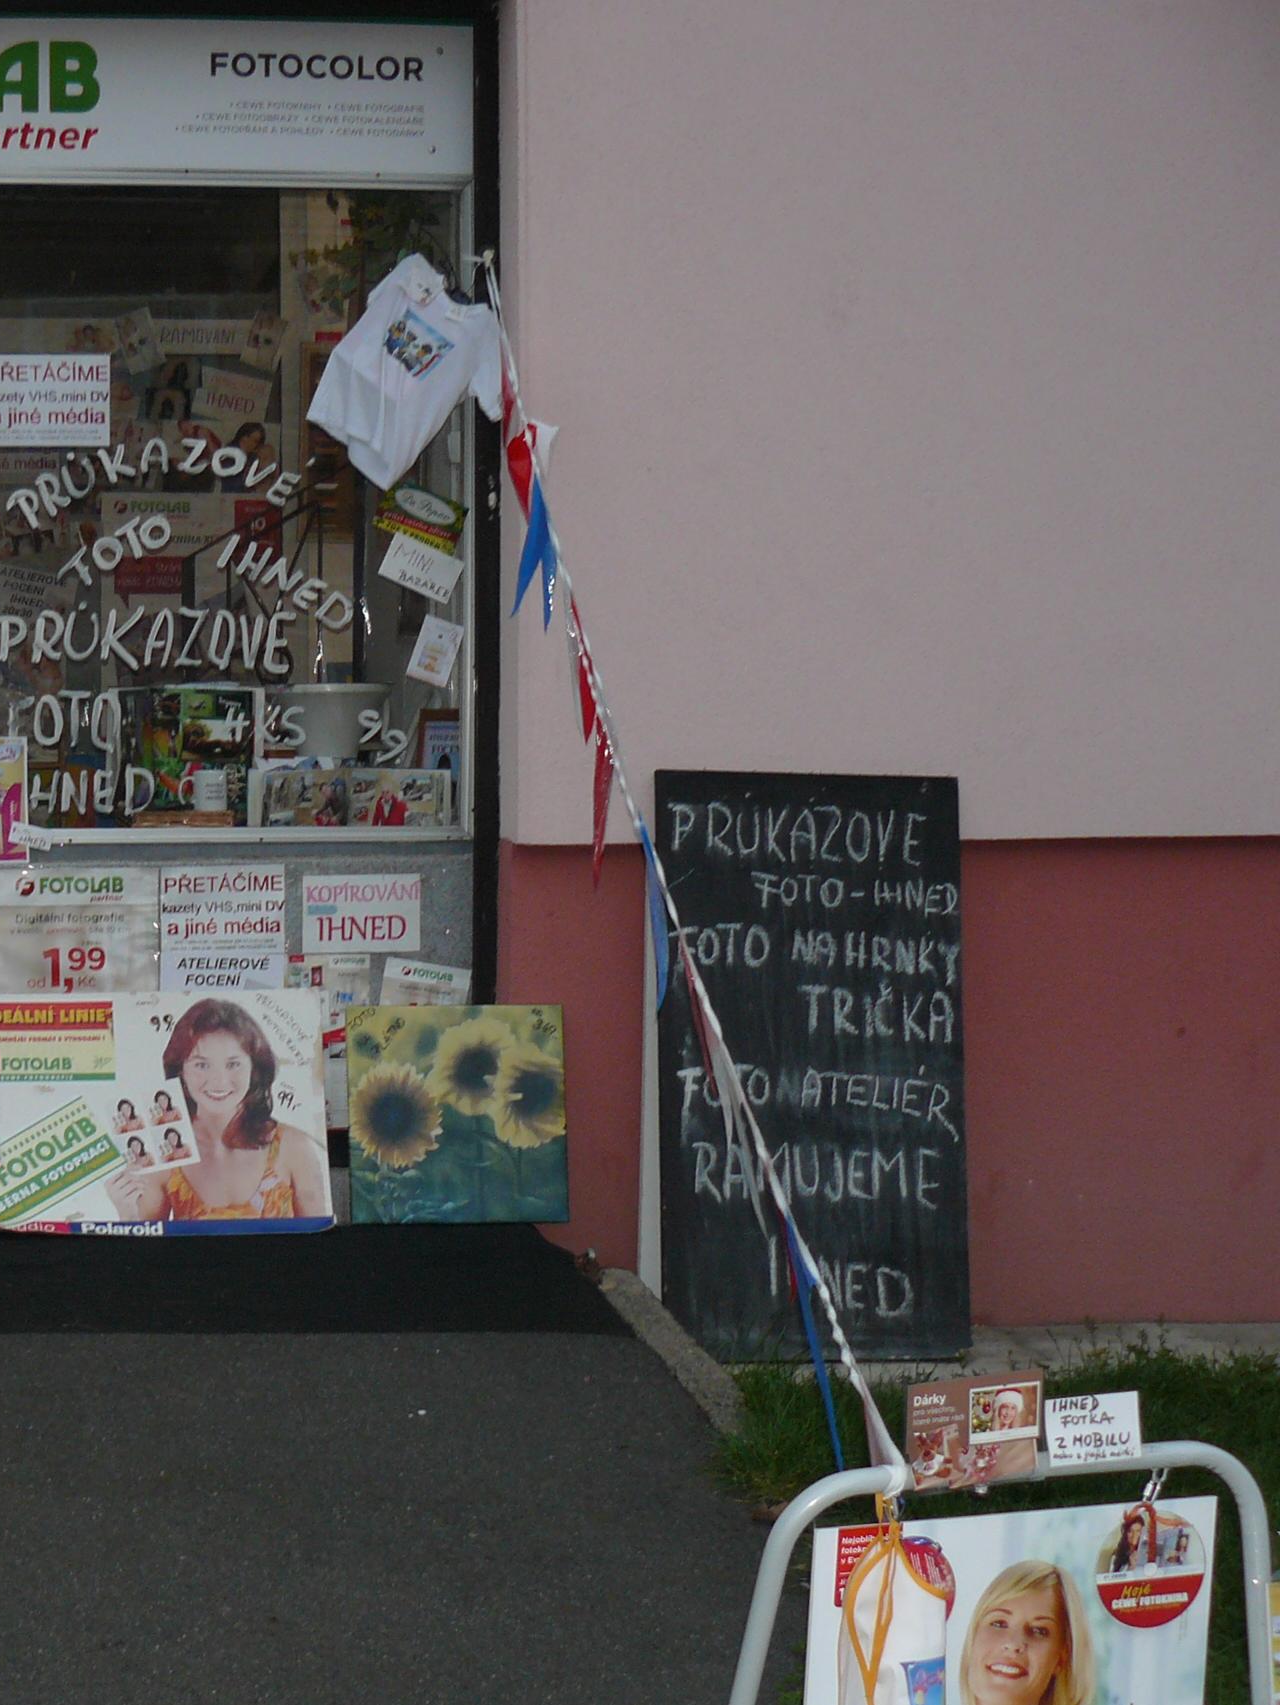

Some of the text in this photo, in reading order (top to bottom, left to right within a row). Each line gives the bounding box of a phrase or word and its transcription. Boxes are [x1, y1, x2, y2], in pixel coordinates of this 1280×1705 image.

[210, 52, 424, 81] FOTOCOLOR
[90, 391, 109, 401] DV
[8, 407, 41, 428] jiné
[48, 407, 105, 424] média
[130, 502, 191, 513] FOTOLAB
[216, 534, 354, 631] IHNED
[29, 763, 155, 816] HNED
[39, 876, 124, 894] FOTOLAB
[164, 872, 283, 894] PŘETÁČÍME
[306, 880, 421, 903] KOPÍROVÁNÍ
[751, 871, 844, 909] FOTO
[162, 900, 201, 915] kazety
[265, 900, 285, 912] DV
[168, 916, 281, 939] a jiné média
[317, 915, 407, 942] IHNED
[668, 922, 770, 968] FOTO
[792, 928, 837, 968] NA
[177, 956, 270, 971] ATELIEROVÉ
[185, 973, 242, 987] FOCENÍ
[797, 979, 955, 1043] TRIČKA
[1, 1057, 72, 1070] FOTOLAB
[13, 1221, 55, 1232] udio
[81, 1220, 164, 1236] Polaroid
[769, 1235, 915, 1318] INED
[913, 1392, 946, 1408] Dárky
[1052, 1393, 1100, 1413] IHNED
[1061, 1411, 1115, 1428] FOTKA
[1073, 1431, 1131, 1448] MOBILU
[1121, 1582, 1151, 1598] Moje
